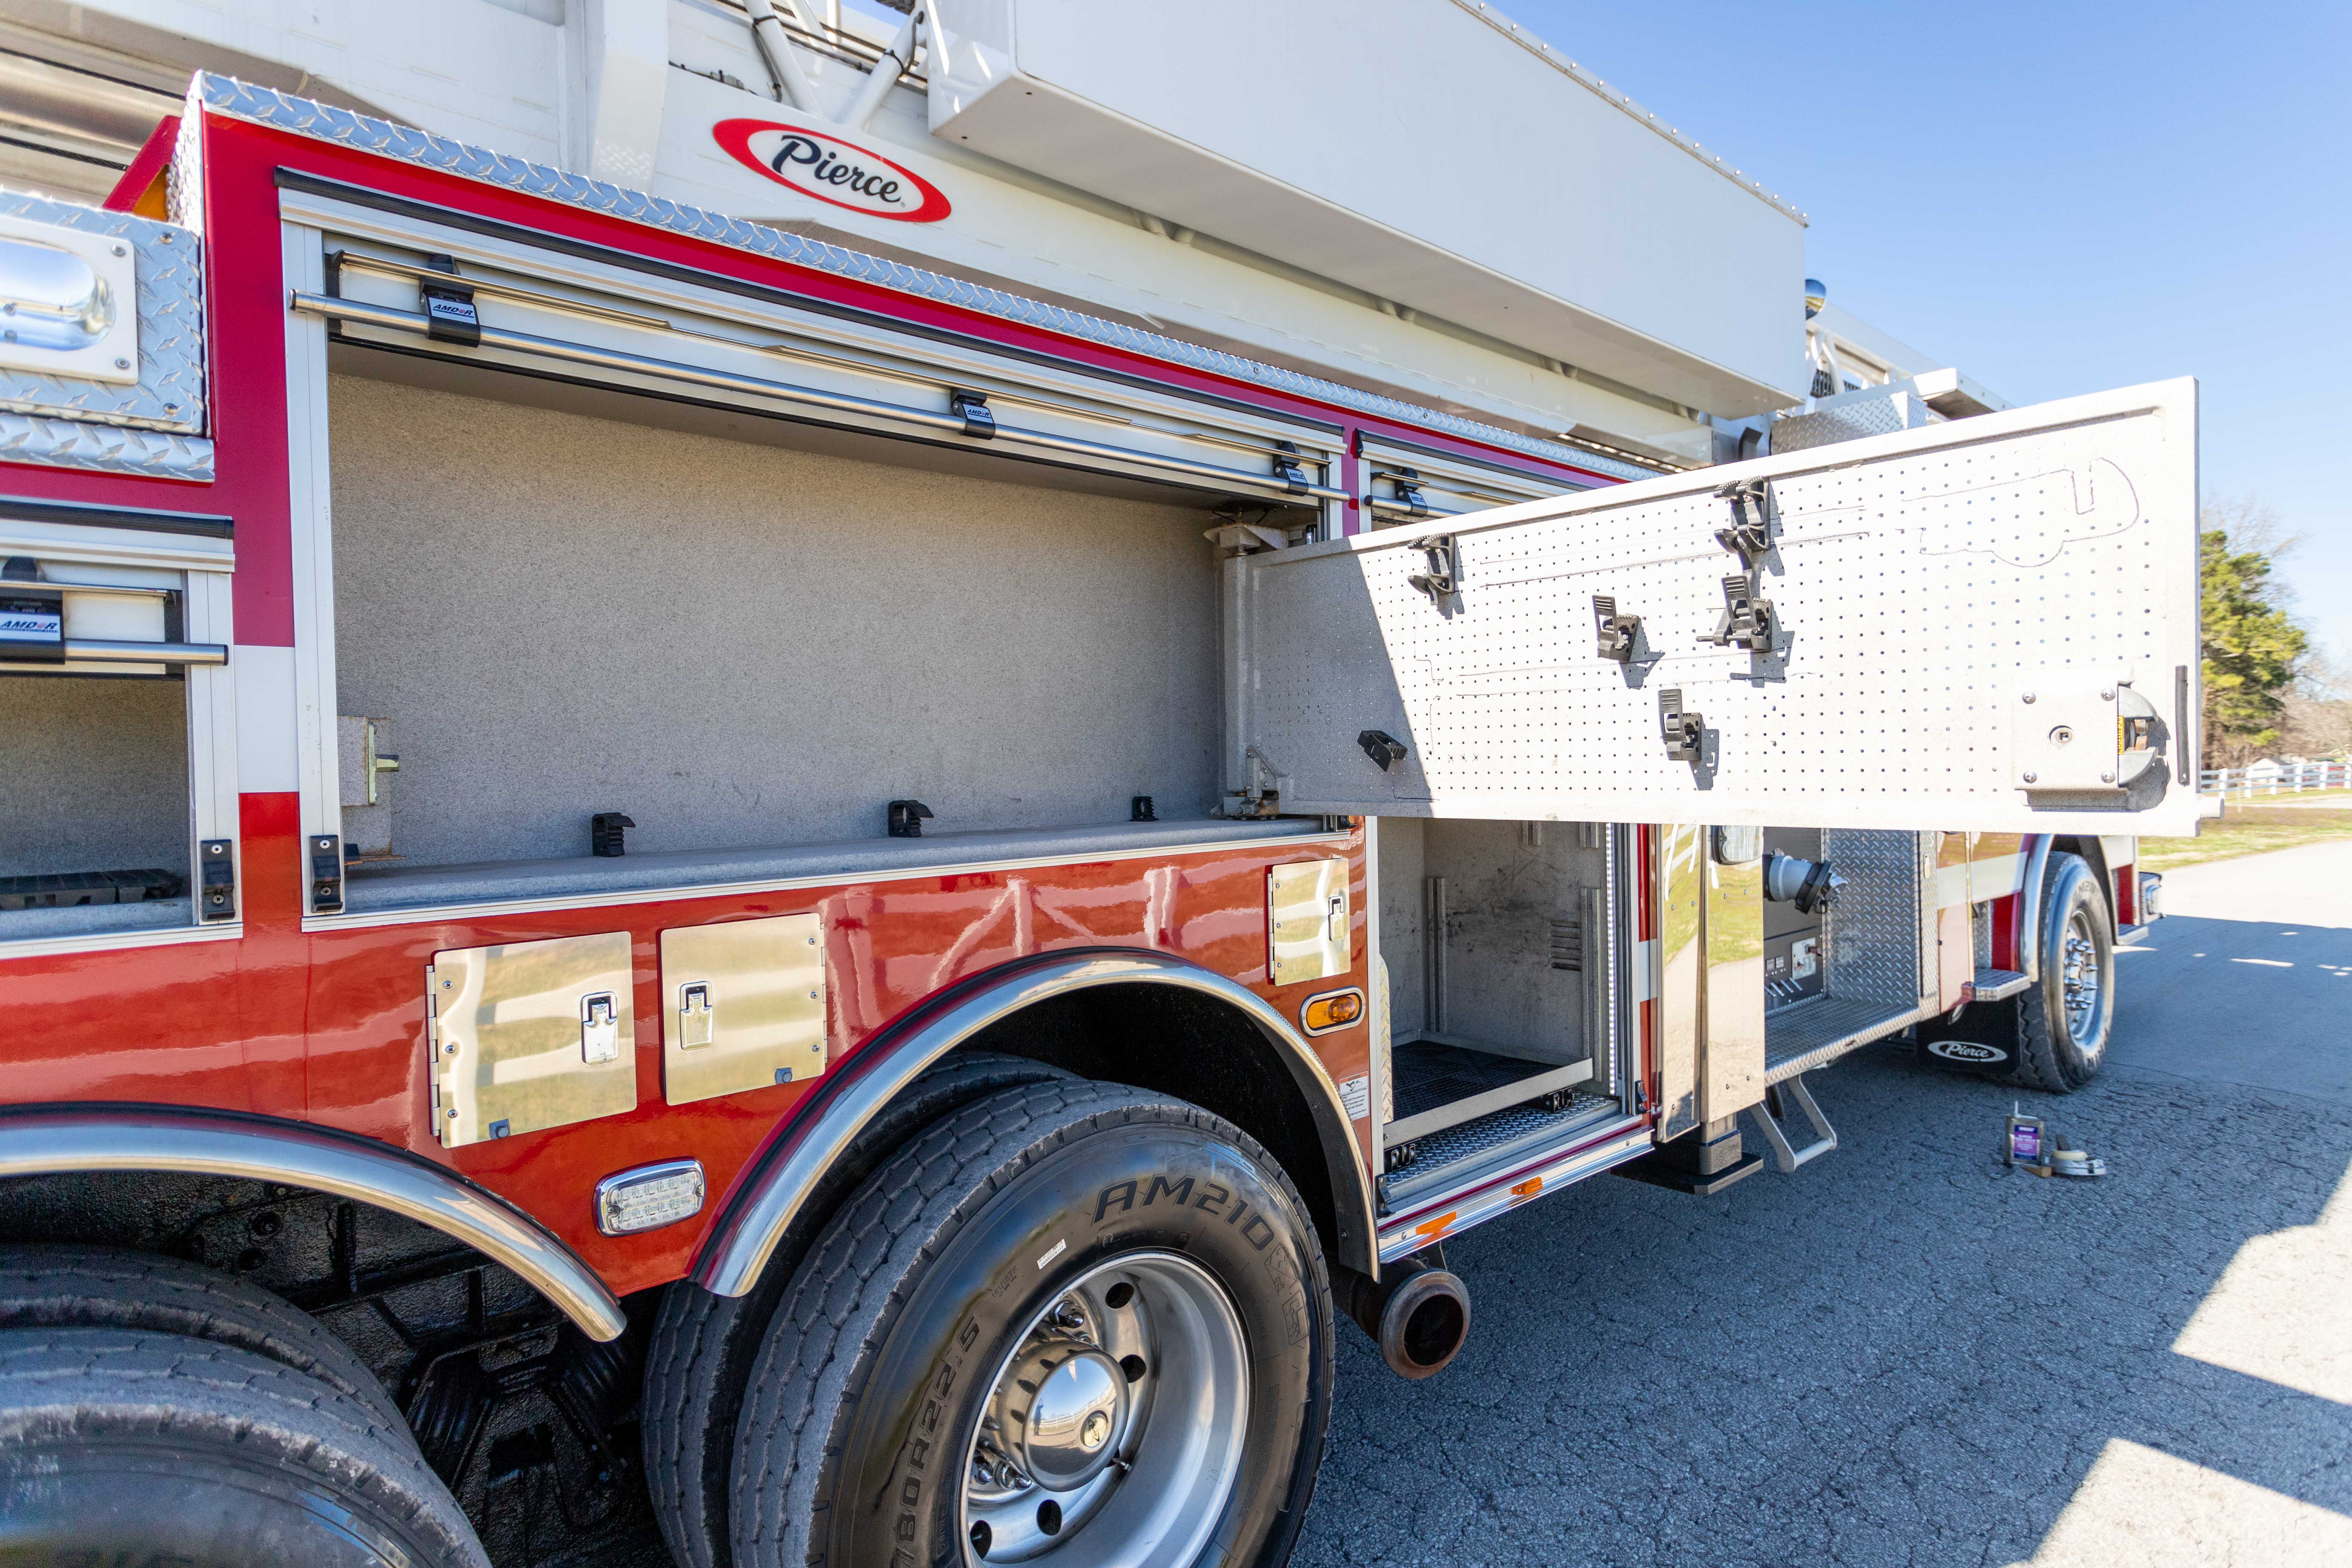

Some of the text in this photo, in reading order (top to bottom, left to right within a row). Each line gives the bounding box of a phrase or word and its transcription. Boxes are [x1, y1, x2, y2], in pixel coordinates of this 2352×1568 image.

[771, 135, 901, 203] Pierce
[1945, 1043, 1989, 1058] Pierce
[1091, 1174, 1275, 1251] AM210
